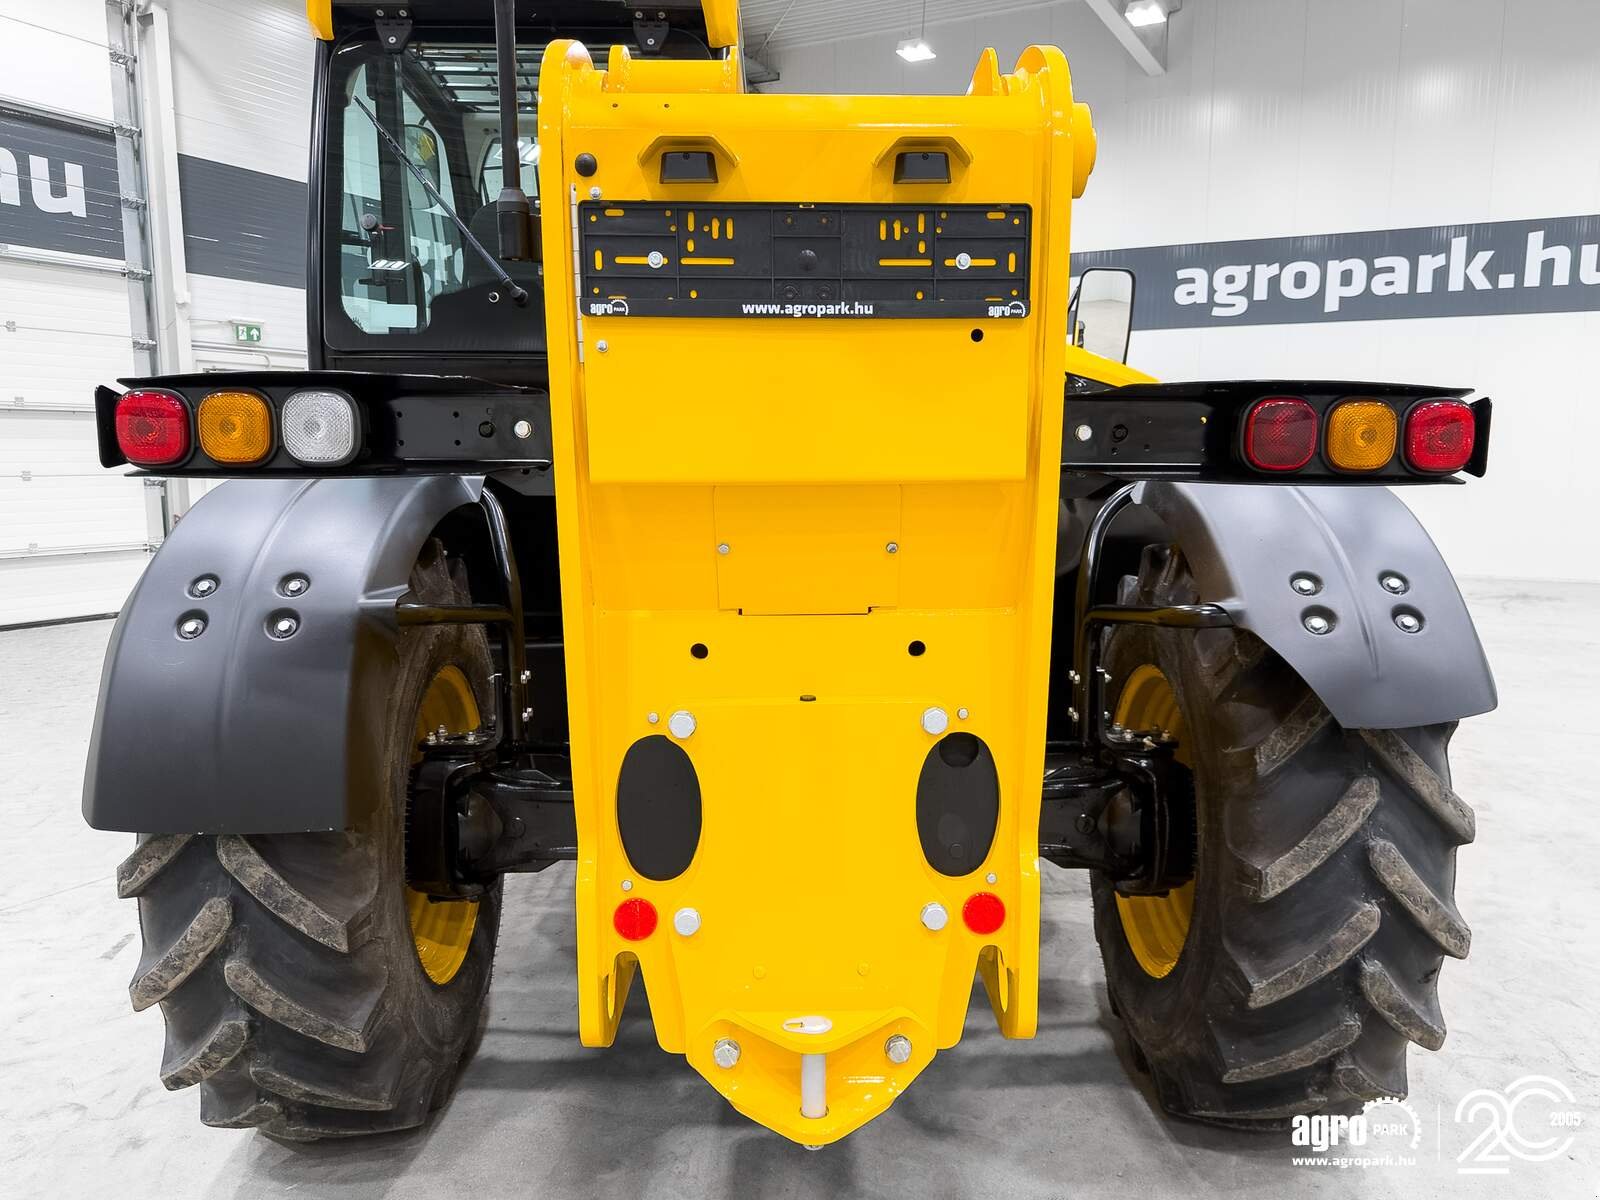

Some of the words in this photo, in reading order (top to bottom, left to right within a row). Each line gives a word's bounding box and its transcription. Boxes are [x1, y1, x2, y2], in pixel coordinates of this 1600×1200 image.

[590, 303, 613, 316] agro
[742, 301, 874, 318] www.agropark.hu
[988, 305, 1010, 318] agro
